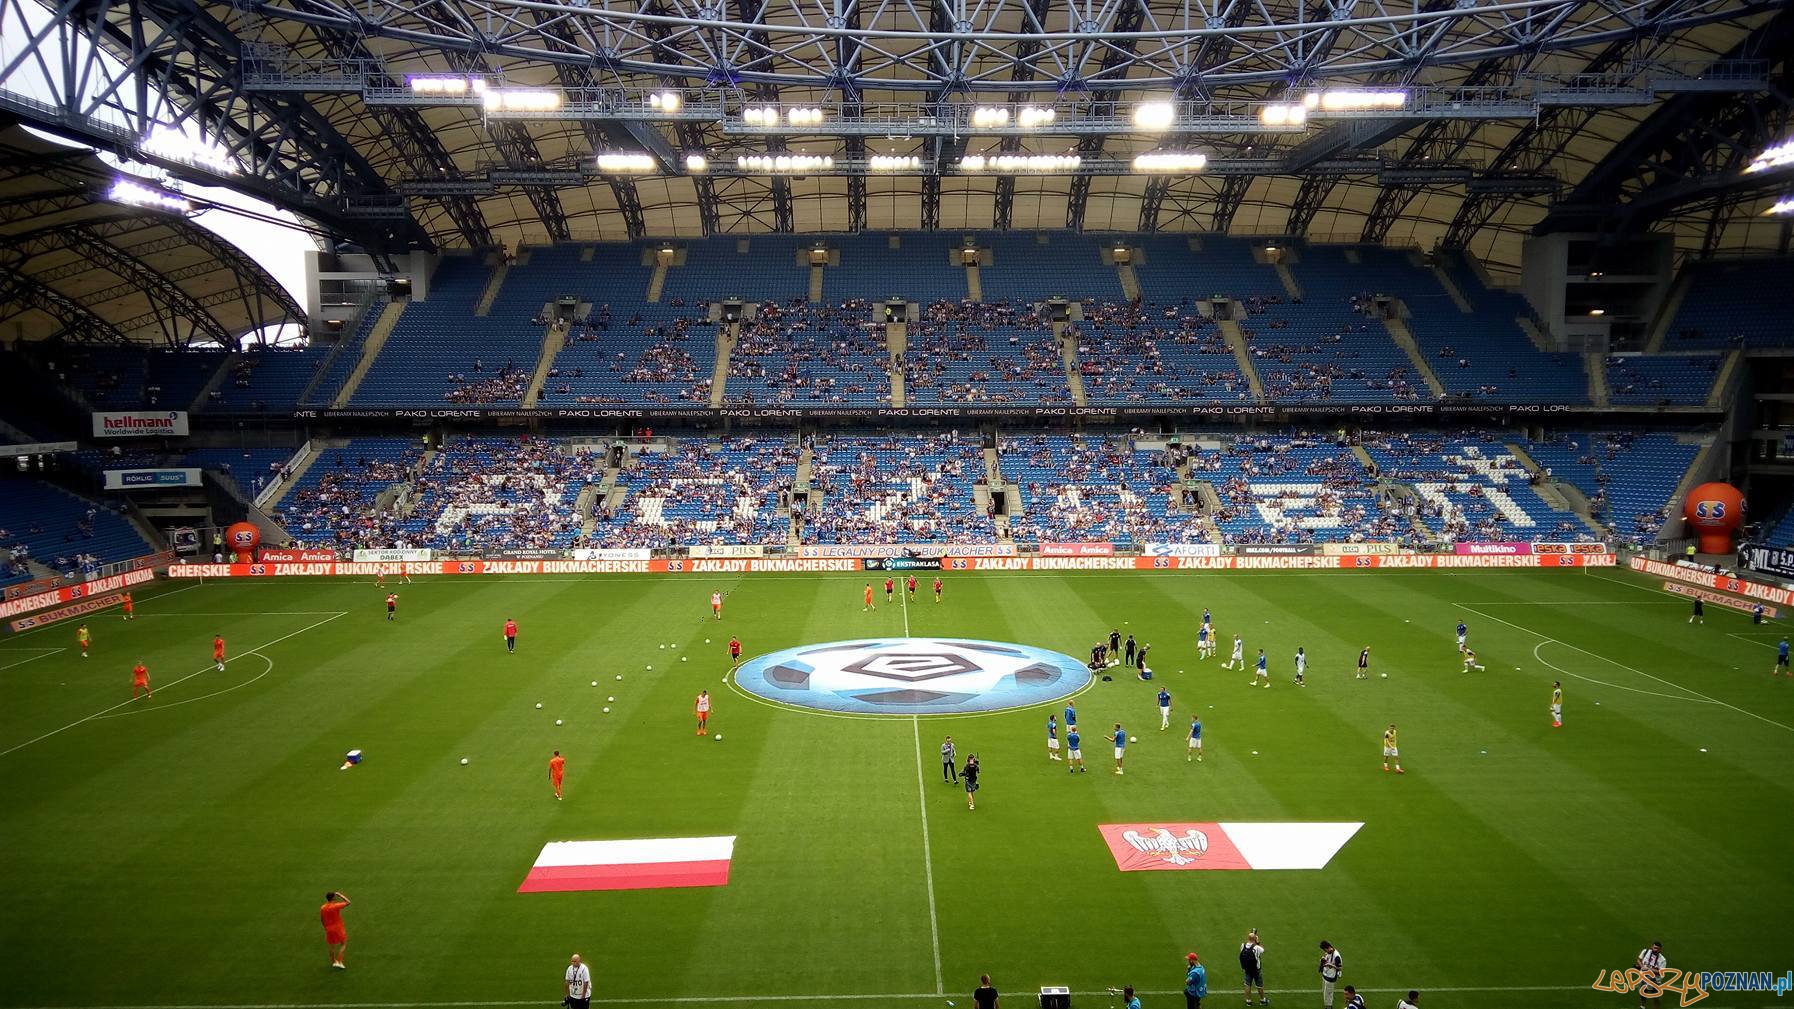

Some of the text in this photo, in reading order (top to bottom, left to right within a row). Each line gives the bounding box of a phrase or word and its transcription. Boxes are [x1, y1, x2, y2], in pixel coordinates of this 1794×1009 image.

[104, 416, 173, 428] hellmann
[732, 546, 756, 555] PILS
[822, 548, 875, 556] LEGALNY
[1044, 546, 1110, 554] Amica Amica
[1174, 546, 1215, 555] AFORTI
[1367, 544, 1392, 553] PILS
[1470, 544, 1517, 554] Multikino
[262, 552, 332, 561] Amica Amica
[274, 564, 331, 576] ZAKŁADY
[482, 561, 540, 573] ZAKŁADY
[542, 560, 650, 573] BUKMACHERSKIE
[692, 560, 748, 572] ZAKŁADY
[750, 559, 854, 572] BUKMACHERSKIE
[974, 558, 1028, 570] ZAKŁADY
[1032, 557, 1136, 570] BUKMACHERSKIE
[1178, 557, 1232, 568] ZAKŁADY
[1236, 556, 1340, 568] BUKMACHERSKIE
[1378, 556, 1433, 568] ZAKŁADY
[1437, 555, 1542, 568] BUKMACHERSKIE
[86, 574, 124, 596] ZAKŁADY
[1646, 560, 1718, 588] BUKMACHERSKIE
[1744, 582, 1791, 605] ZAKŁADY
[38, 595, 121, 624] BUKMACHER
